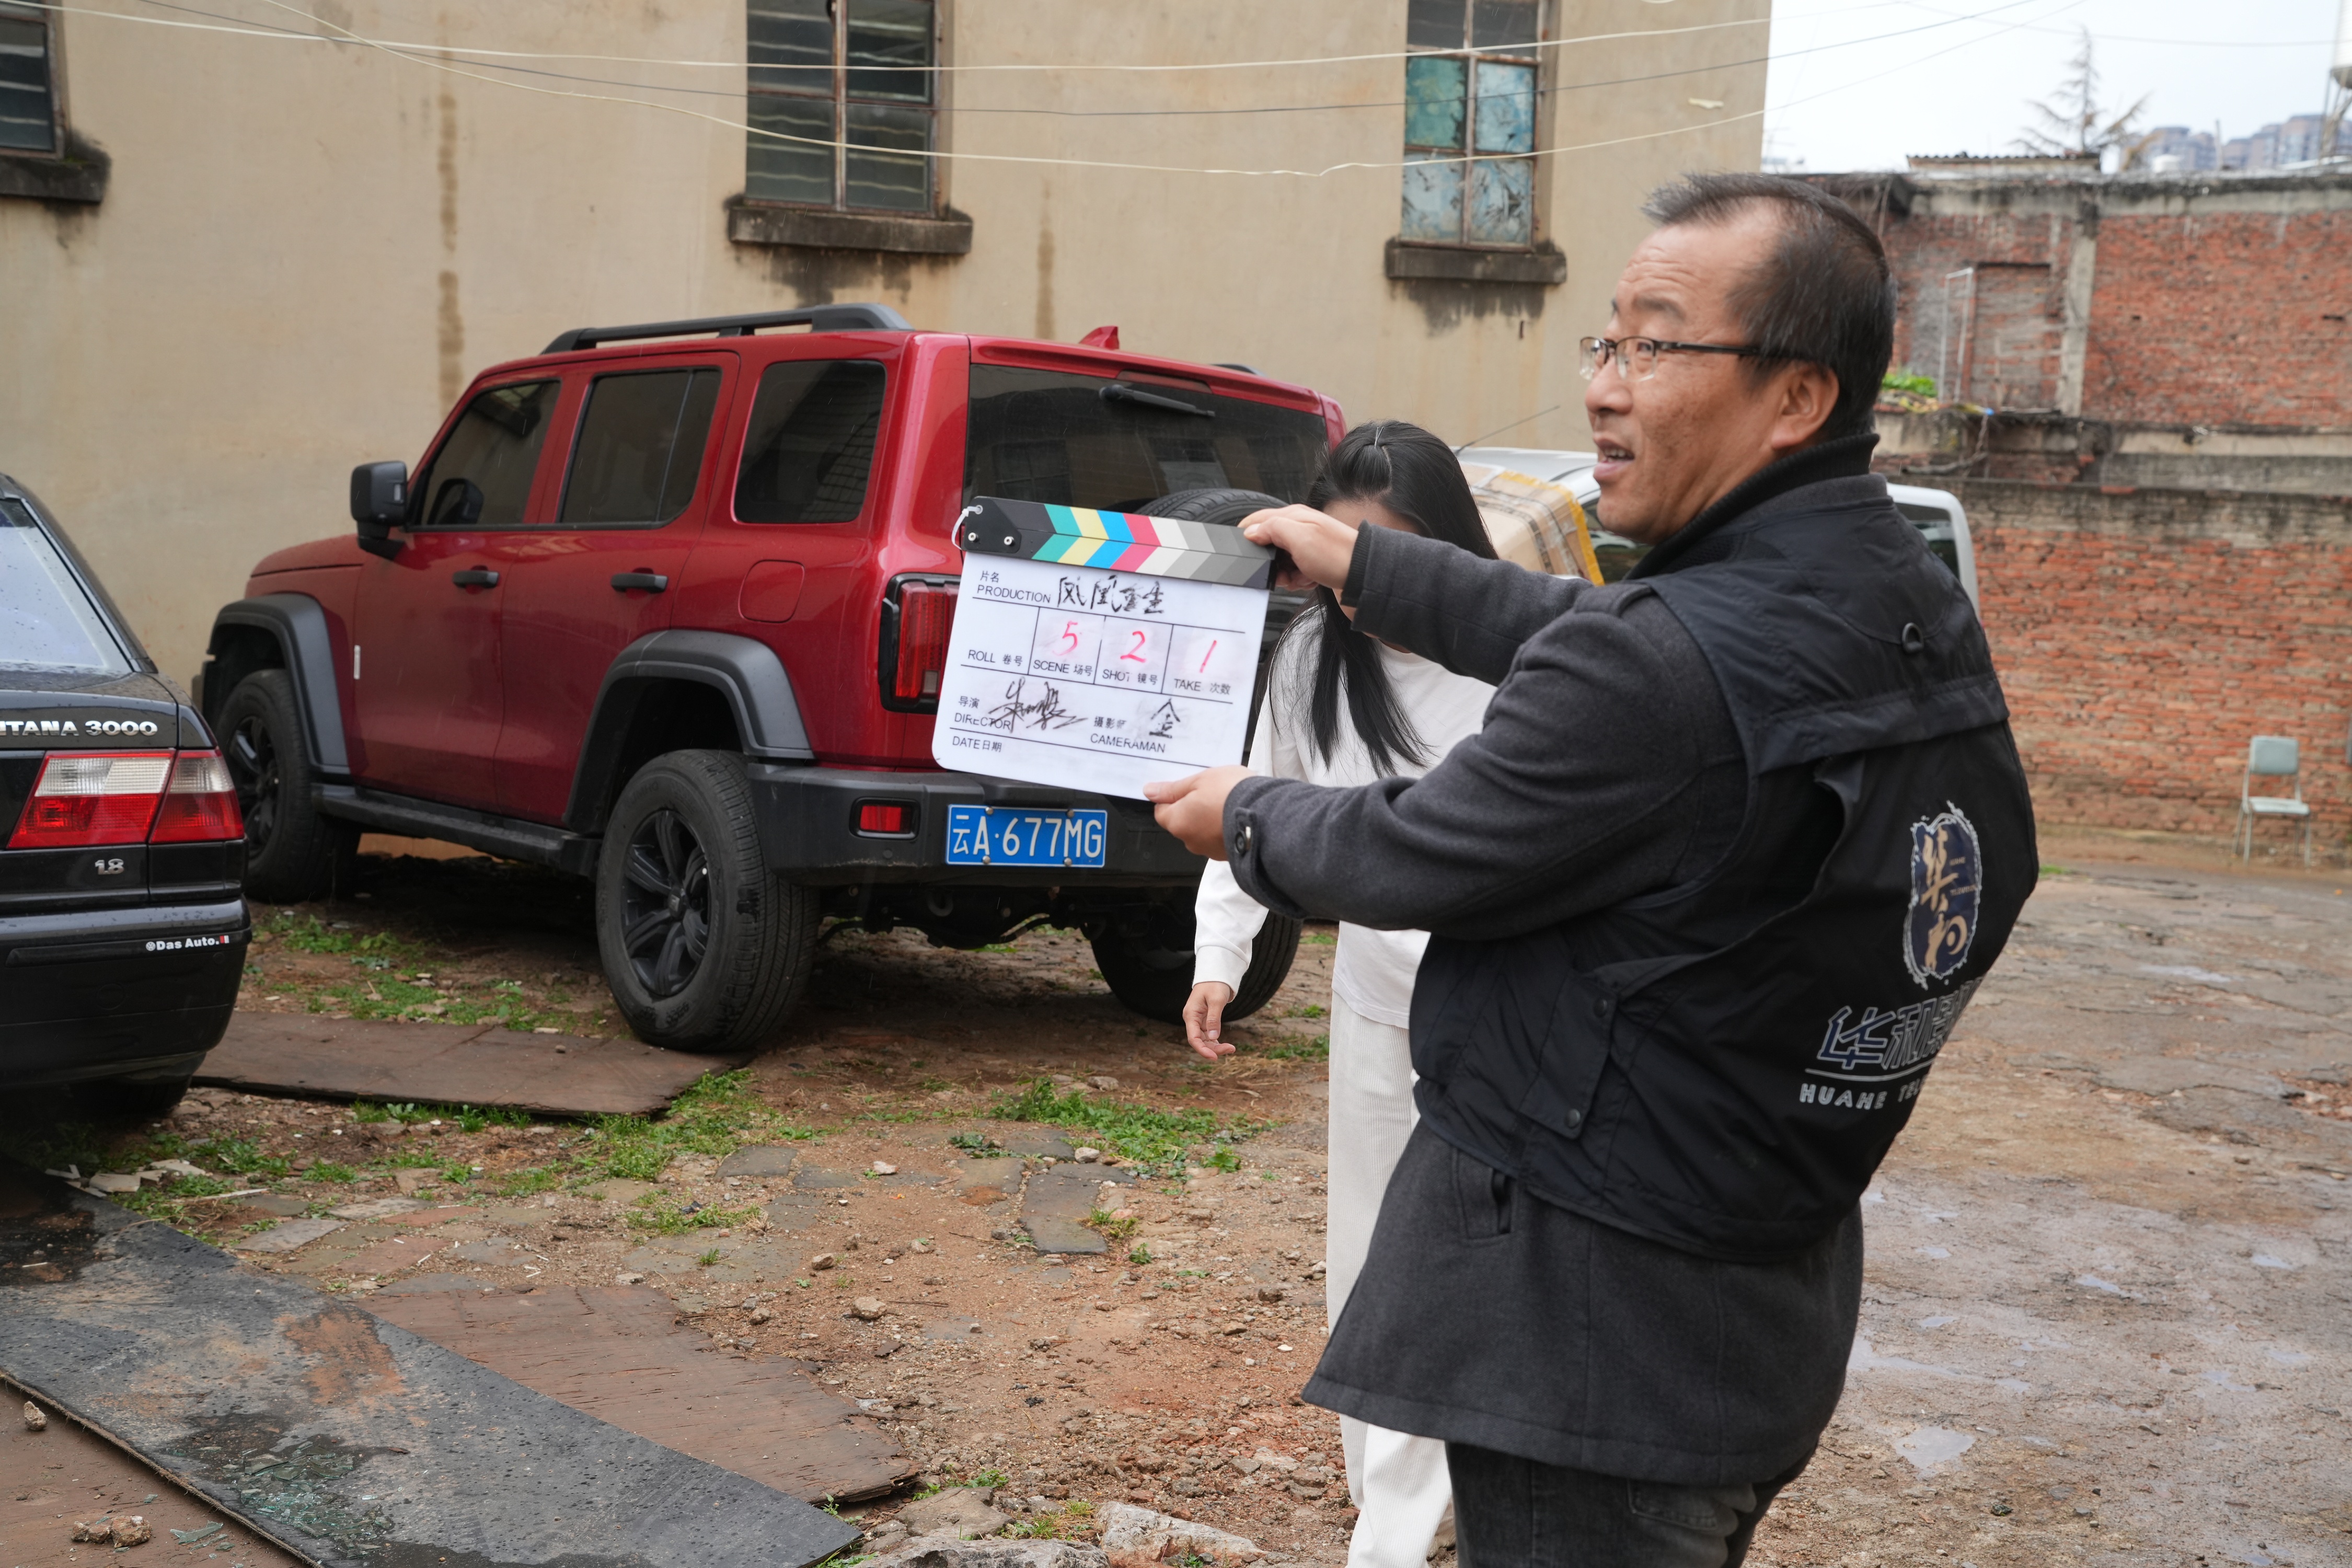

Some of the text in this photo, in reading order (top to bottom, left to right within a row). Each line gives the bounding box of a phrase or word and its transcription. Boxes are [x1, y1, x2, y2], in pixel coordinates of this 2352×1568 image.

[980, 570, 999, 583] 片名
[977, 584, 1051, 603] PRODUCTION
[1052, 620, 1078, 656] 5
[1120, 630, 1146, 663] 2
[968, 650, 1023, 666] ROLL 卷号
[1199, 640, 1217, 673] 1
[1033, 660, 1093, 676] SCENE 场号
[1102, 670, 1158, 685] SHOT 镜号
[1174, 678, 1231, 695] TAKE 次数
[959, 696, 979, 709] 导演
[85, 720, 158, 736] 3000
[954, 712, 1011, 731] DIRECTOR
[1090, 733, 1166, 753] CAMERAMAN
[156, 941, 182, 951] Das
[185, 937, 220, 948] Auto.
[1800, 1083, 1887, 1110] HUAHE
